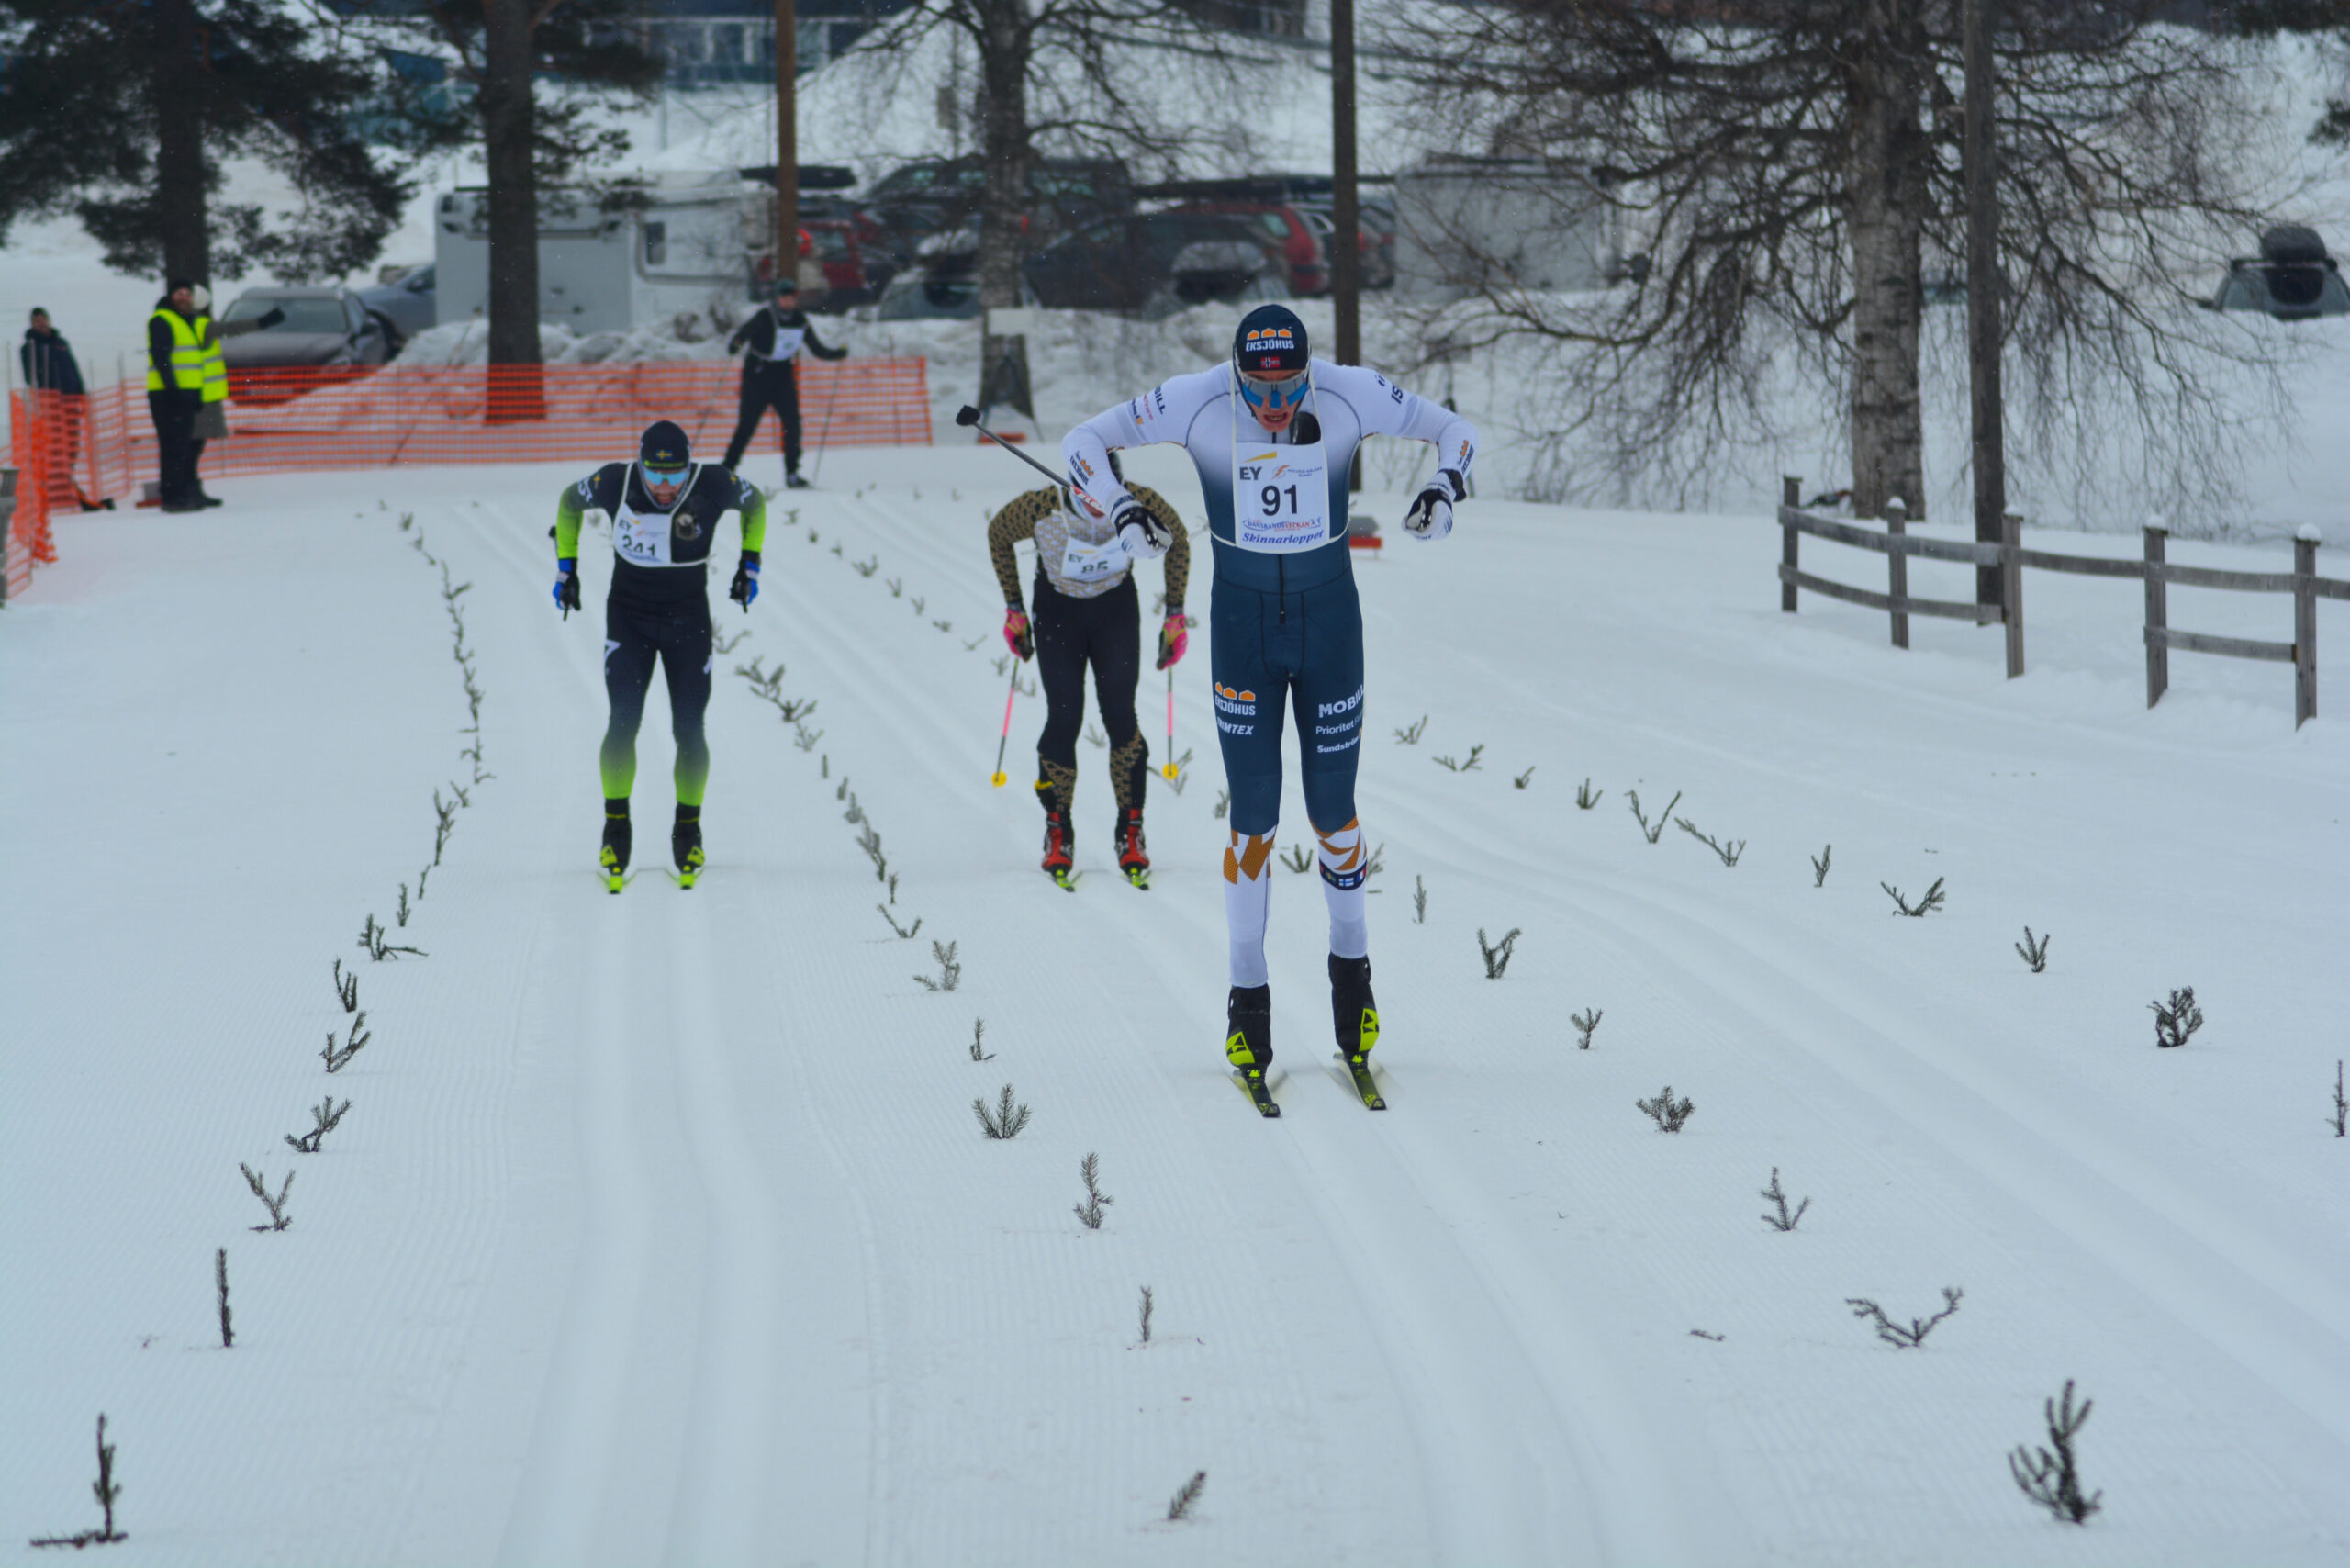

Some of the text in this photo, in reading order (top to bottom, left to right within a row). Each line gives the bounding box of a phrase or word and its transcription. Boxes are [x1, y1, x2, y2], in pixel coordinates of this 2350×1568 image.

[1246, 339, 1294, 352] EKSJÖHUS
[1239, 466, 1262, 480] EY
[1261, 484, 1298, 517] 91
[619, 519, 632, 532] EY
[1242, 530, 1324, 544] Skinnarloppet
[622, 534, 655, 556] 241
[1069, 553, 1084, 564] EY
[1315, 720, 1354, 734] Prioritet
